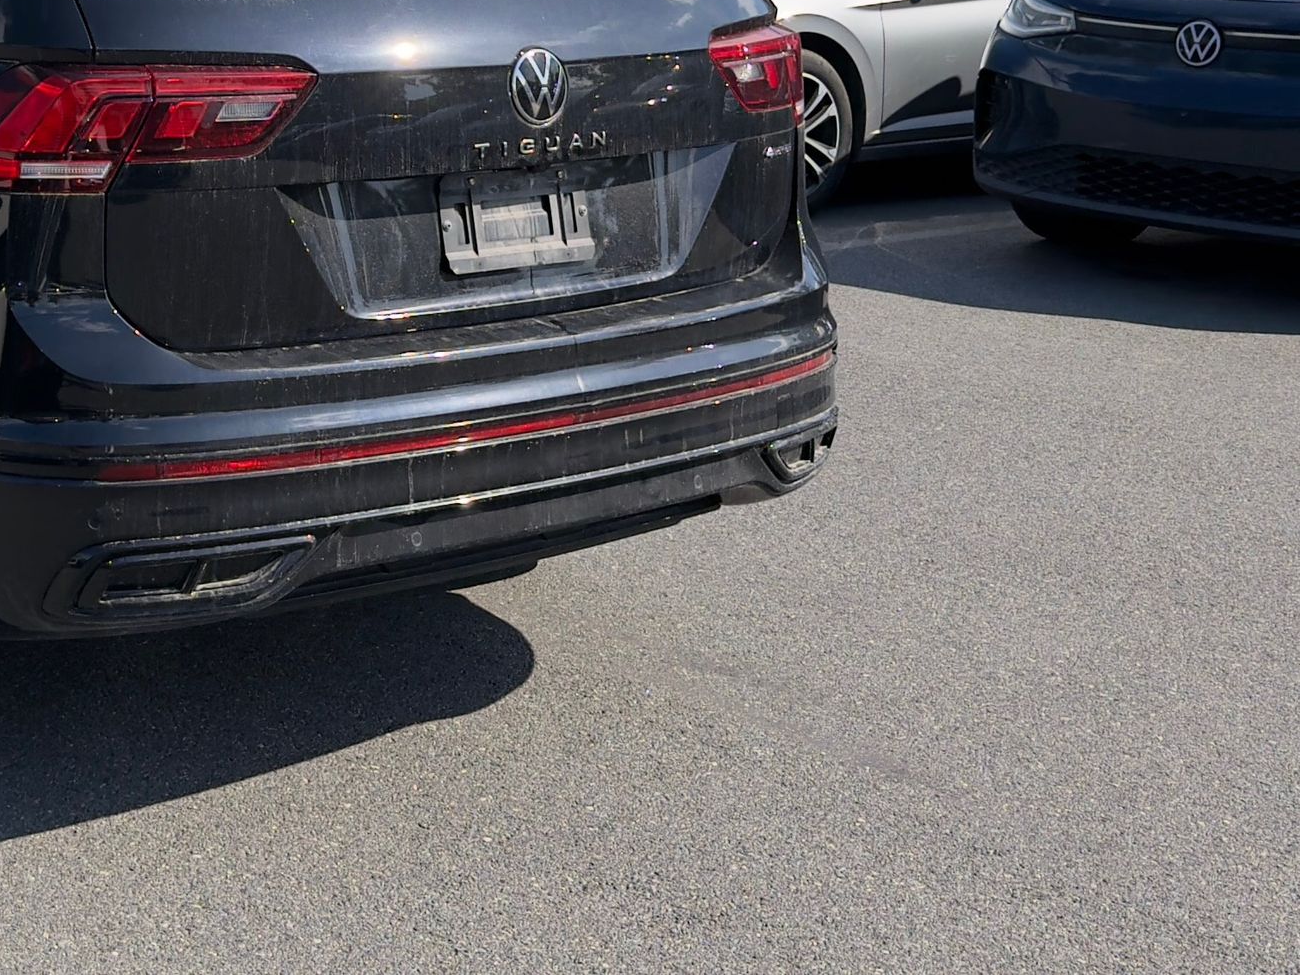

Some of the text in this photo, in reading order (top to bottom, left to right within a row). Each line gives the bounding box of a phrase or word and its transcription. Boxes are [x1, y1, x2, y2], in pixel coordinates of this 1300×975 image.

[1178, 22, 1220, 65] VW
[513, 50, 566, 123] VW
[473, 130, 607, 159] TIGUAN
